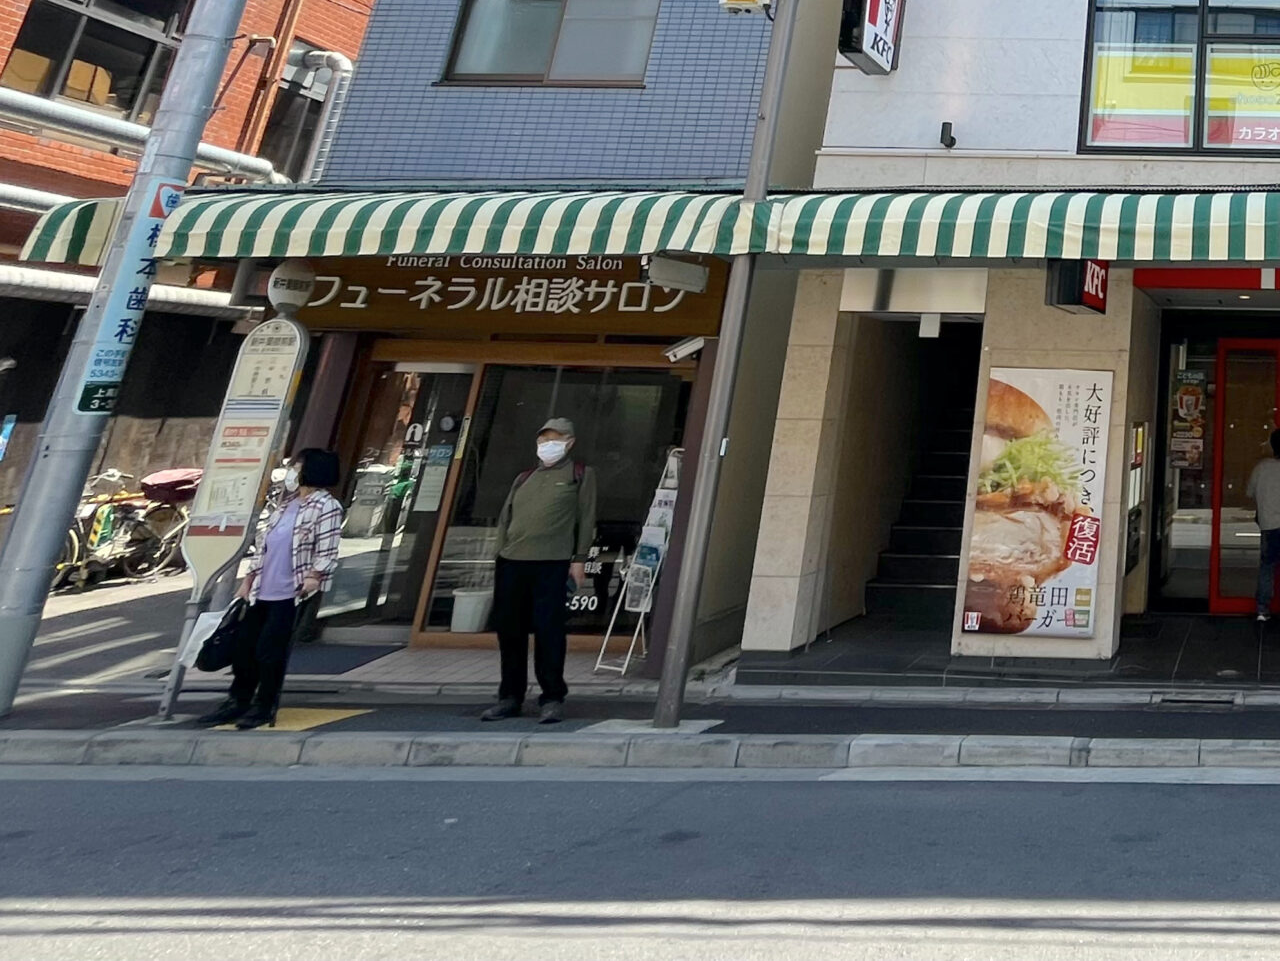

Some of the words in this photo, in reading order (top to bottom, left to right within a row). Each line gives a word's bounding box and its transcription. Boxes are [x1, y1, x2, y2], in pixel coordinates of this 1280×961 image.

[870, 32, 892, 64] KFC
[386, 255, 450, 269] Funeral
[460, 255, 567, 270] Consultation
[576, 256, 623, 270] Salon
[1084, 260, 1106, 299] KFC
[307, 275, 687, 313] フューネラル相談サロン
[1080, 383, 1103, 513] 大好評につき、
[1067, 517, 1100, 562] 復活
[1007, 584, 1068, 607] 鶏竜田
